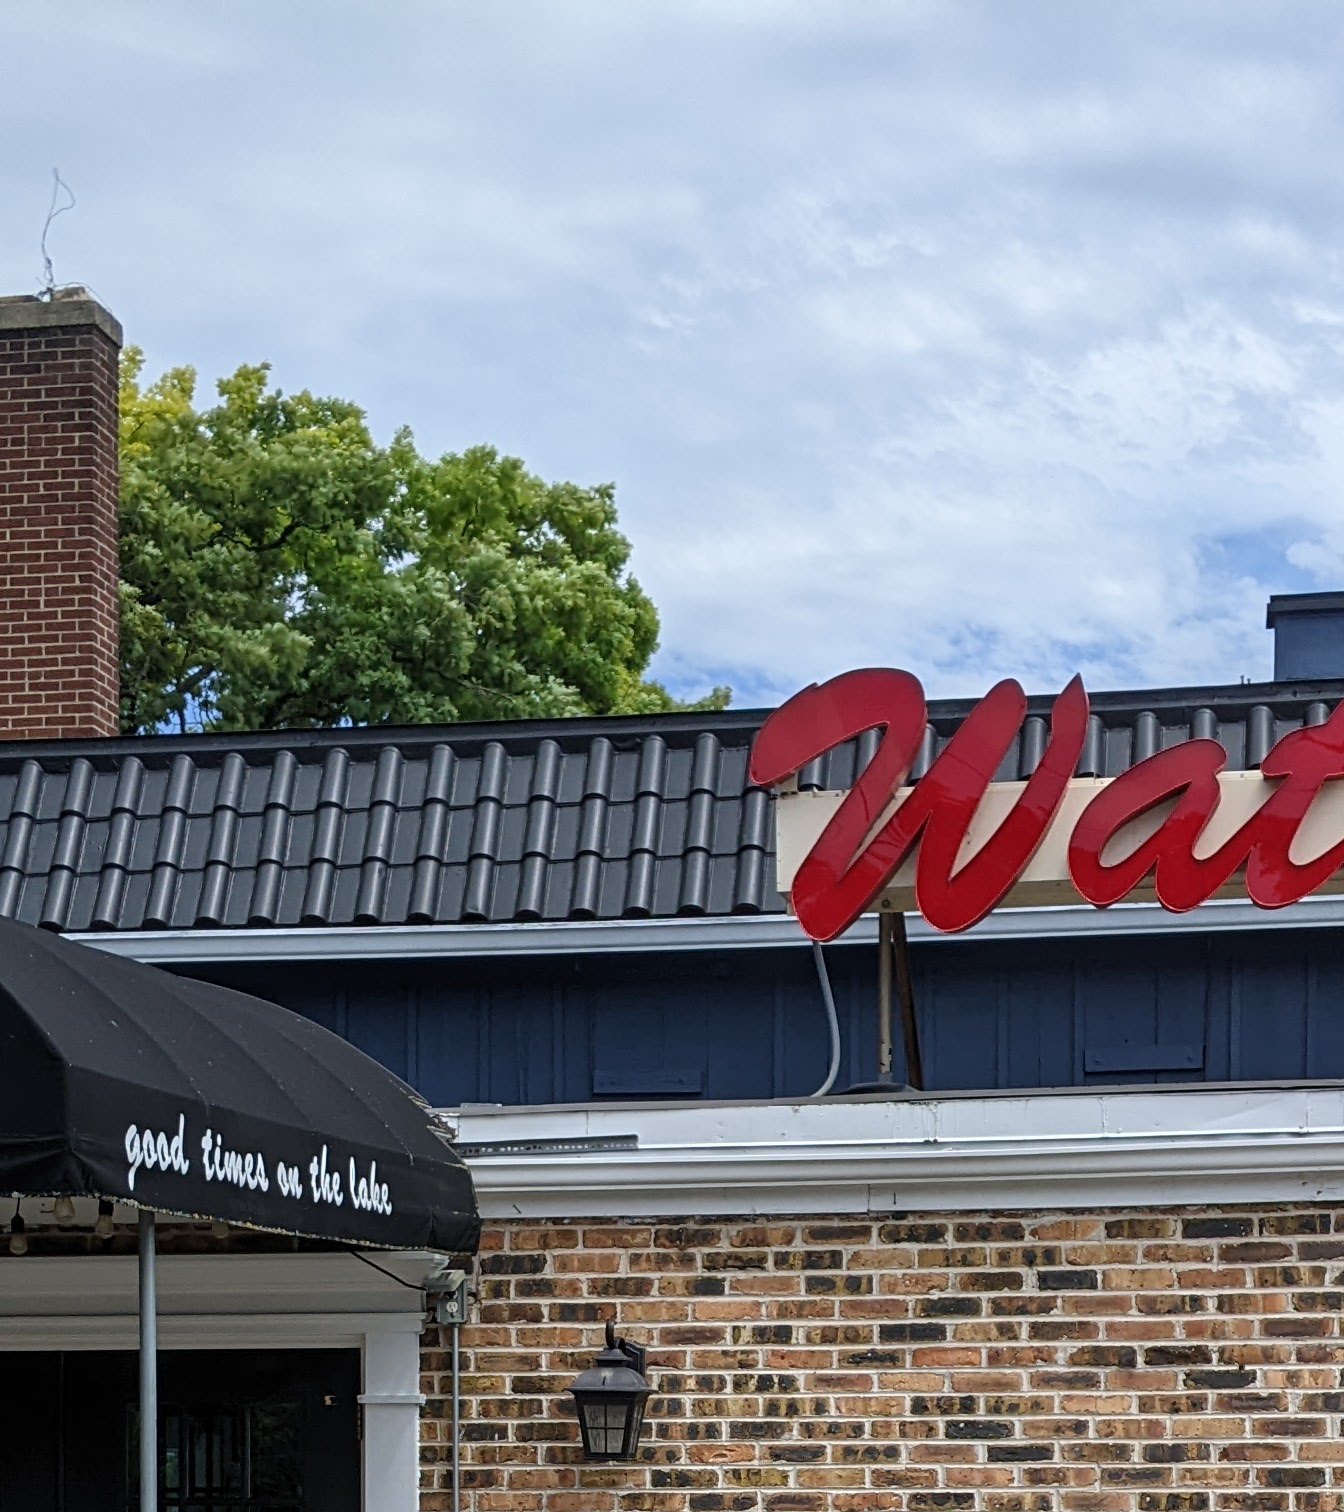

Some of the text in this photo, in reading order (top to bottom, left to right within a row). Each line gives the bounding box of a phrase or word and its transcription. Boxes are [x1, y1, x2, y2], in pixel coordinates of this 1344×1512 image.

[124, 1112, 393, 1216] good times on the lake
